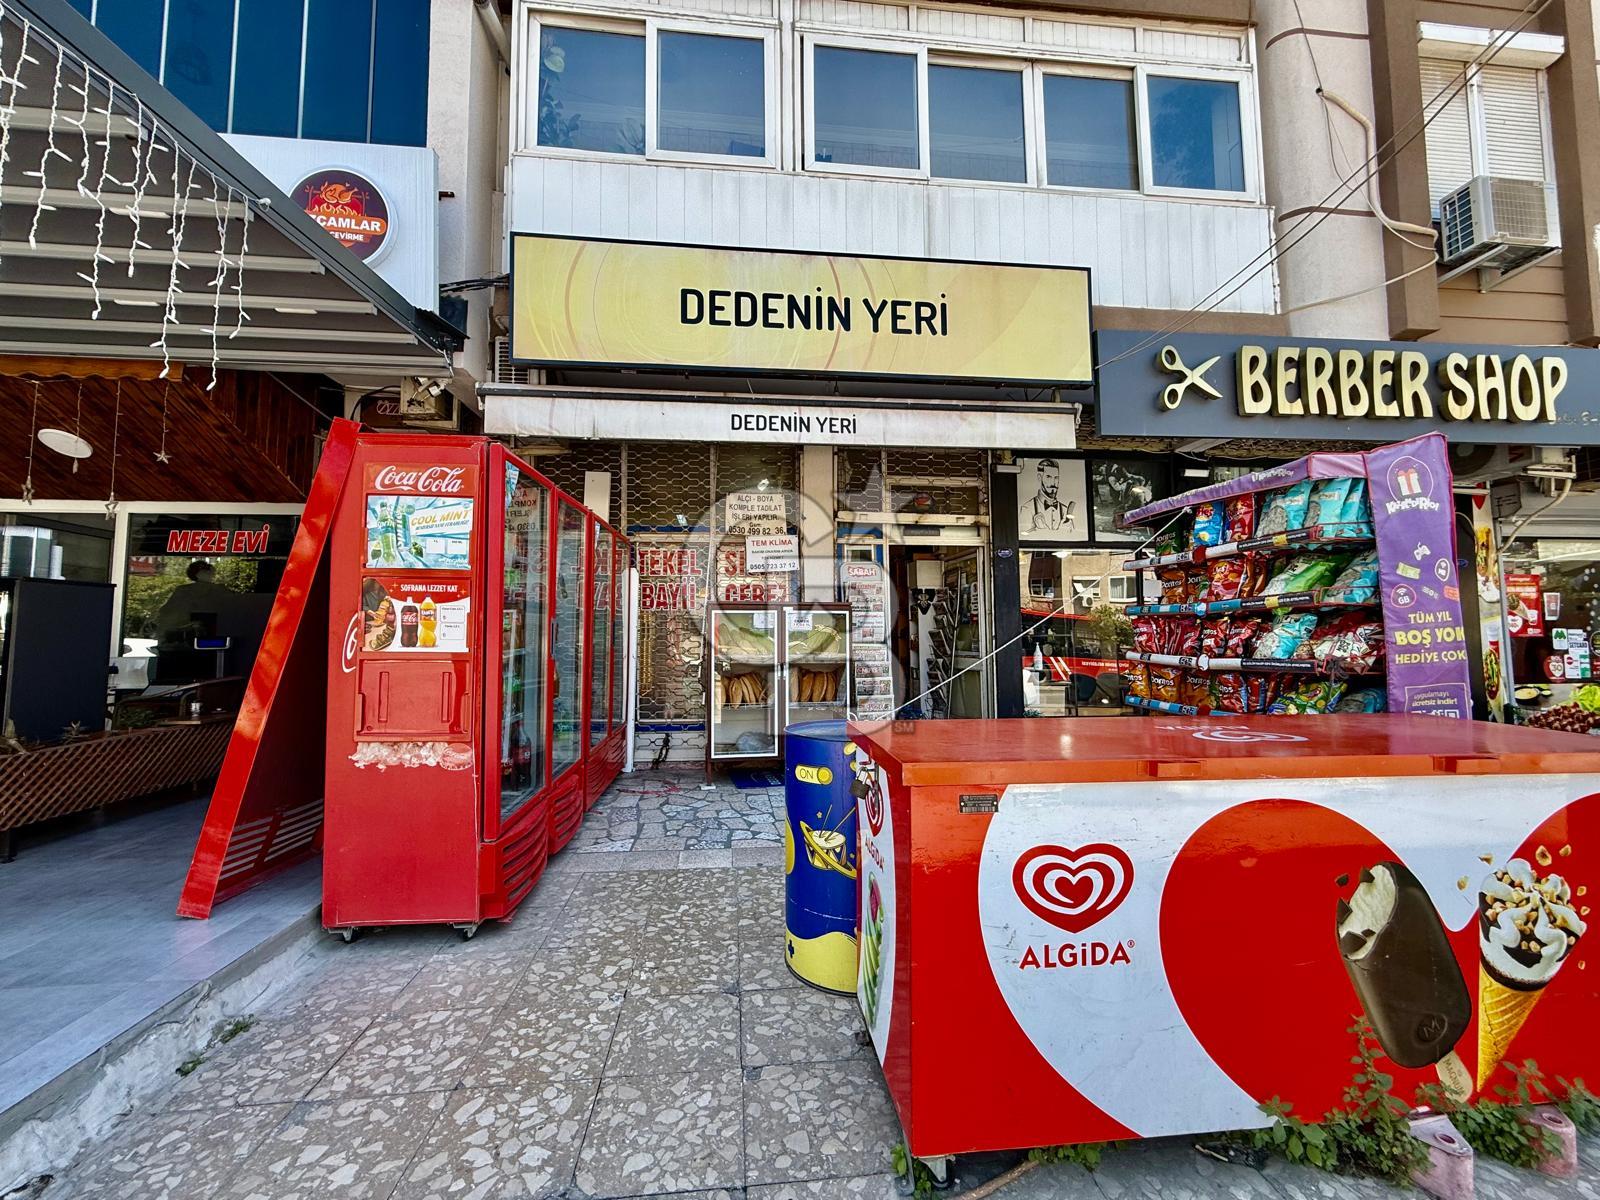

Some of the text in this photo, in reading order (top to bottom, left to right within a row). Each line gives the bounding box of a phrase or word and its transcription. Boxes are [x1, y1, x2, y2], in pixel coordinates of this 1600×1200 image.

[680, 287, 948, 336] DEDENİN YERİ
[1237, 345, 1568, 421] BERBER SHOP
[731, 412, 857, 434] DEDENİN YERİ
[375, 465, 465, 493] Coca-Cola
[411, 516, 437, 526] COOL
[440, 510, 470, 521] MINT
[167, 524, 270, 552] MEZE EVİ
[728, 526, 746, 535] 0530
[748, 527, 760, 535] 499
[638, 549, 703, 577] TEKEL
[848, 567, 877, 576] SABAH
[401, 584, 426, 592] SOFRANA
[641, 577, 697, 611] BAYİİ
[1398, 596, 1410, 604] GB
[1408, 611, 1453, 624] TÜM YIL
[1394, 628, 1431, 648] BOŞ
[1395, 649, 1467, 664] HEDİYE ÇOK
[1414, 691, 1449, 700] uygulamayı
[800, 769, 814, 780] ON
